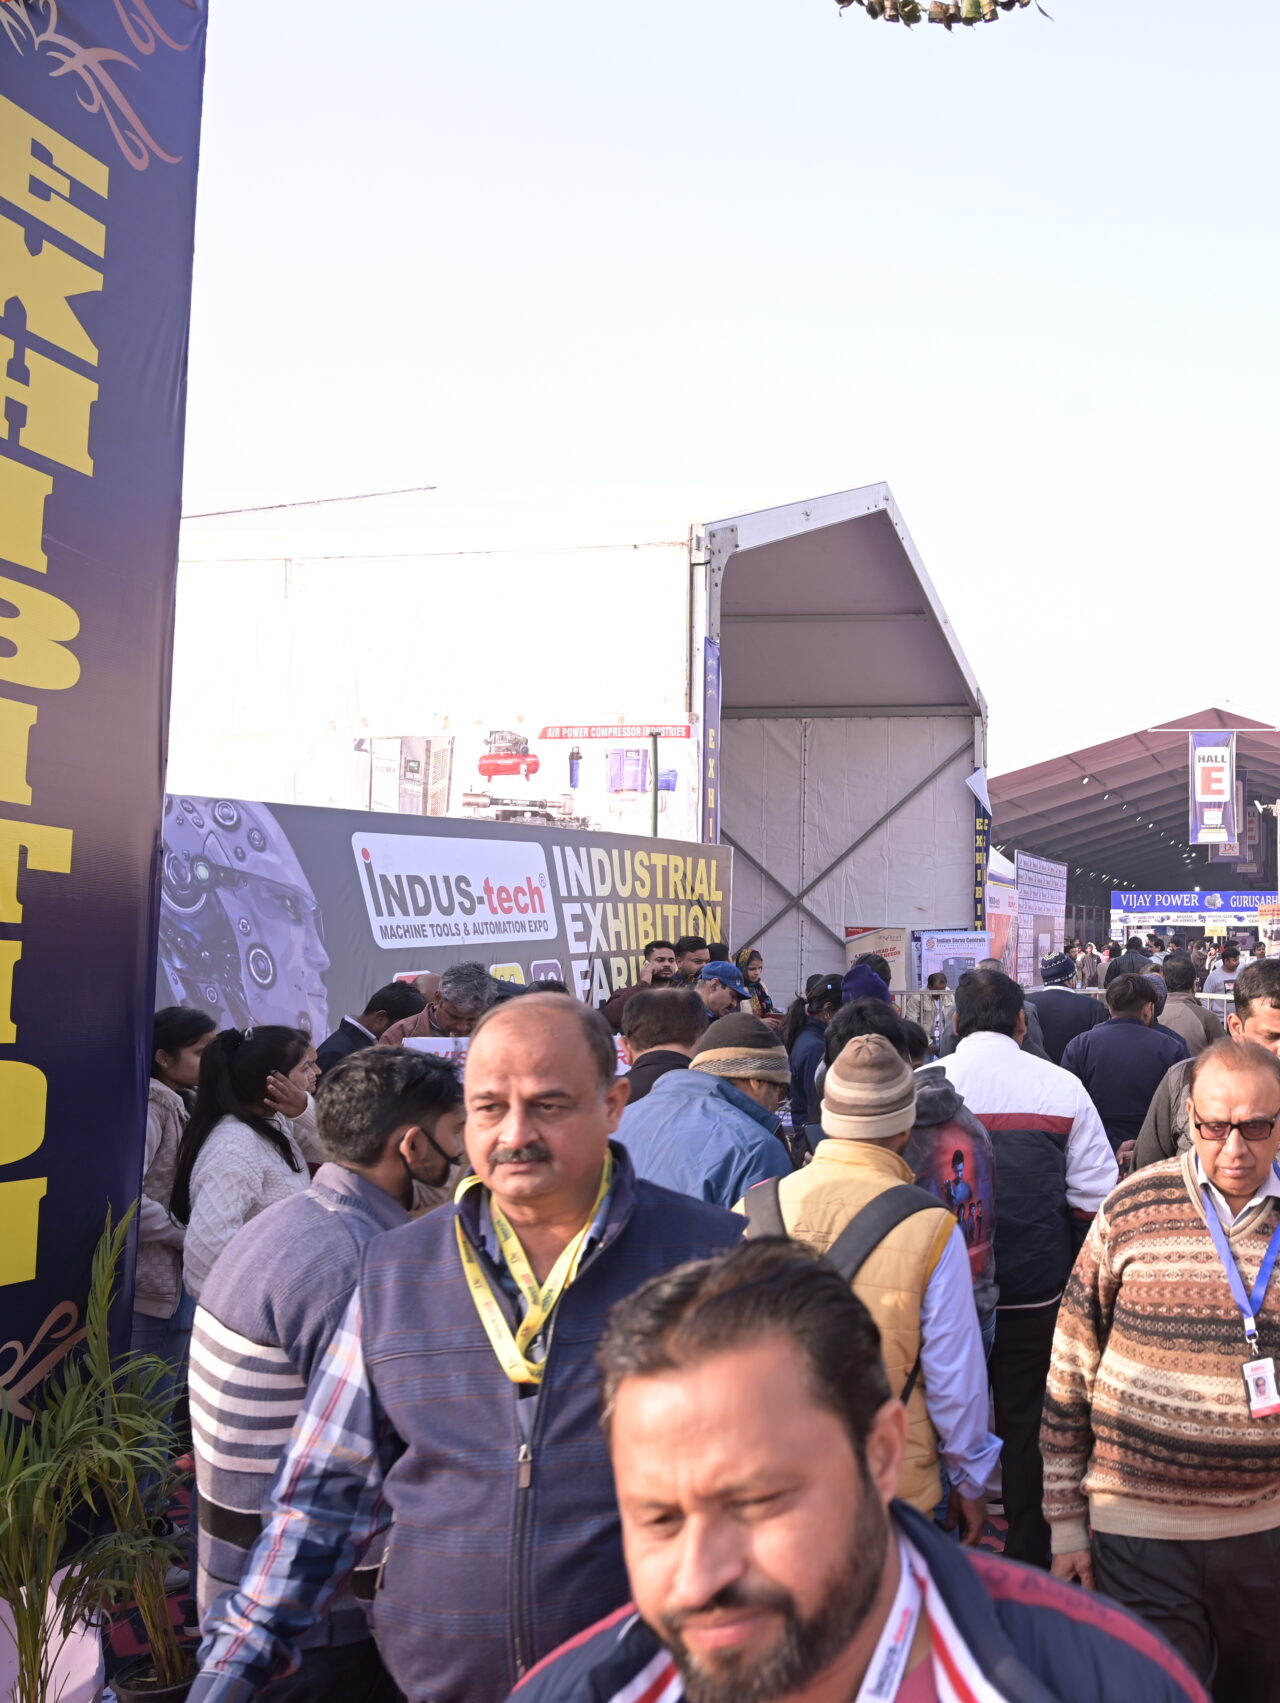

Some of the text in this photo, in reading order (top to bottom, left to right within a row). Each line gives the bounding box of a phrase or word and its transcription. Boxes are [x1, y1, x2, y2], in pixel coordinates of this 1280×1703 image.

[547, 727, 560, 738] AIR
[562, 727, 588, 738] POWER
[591, 727, 641, 737] COMPRESSOR
[1197, 755, 1227, 763] HALL
[1200, 766, 1225, 796] E
[552, 846, 723, 901] INDUSTRIAL
[1121, 894, 1199, 908] VIJAY POWER
[380, 919, 549, 940] MACHINE TOOLS & AUTOMATION EXPO
[563, 902, 723, 954] EXHIBITION
